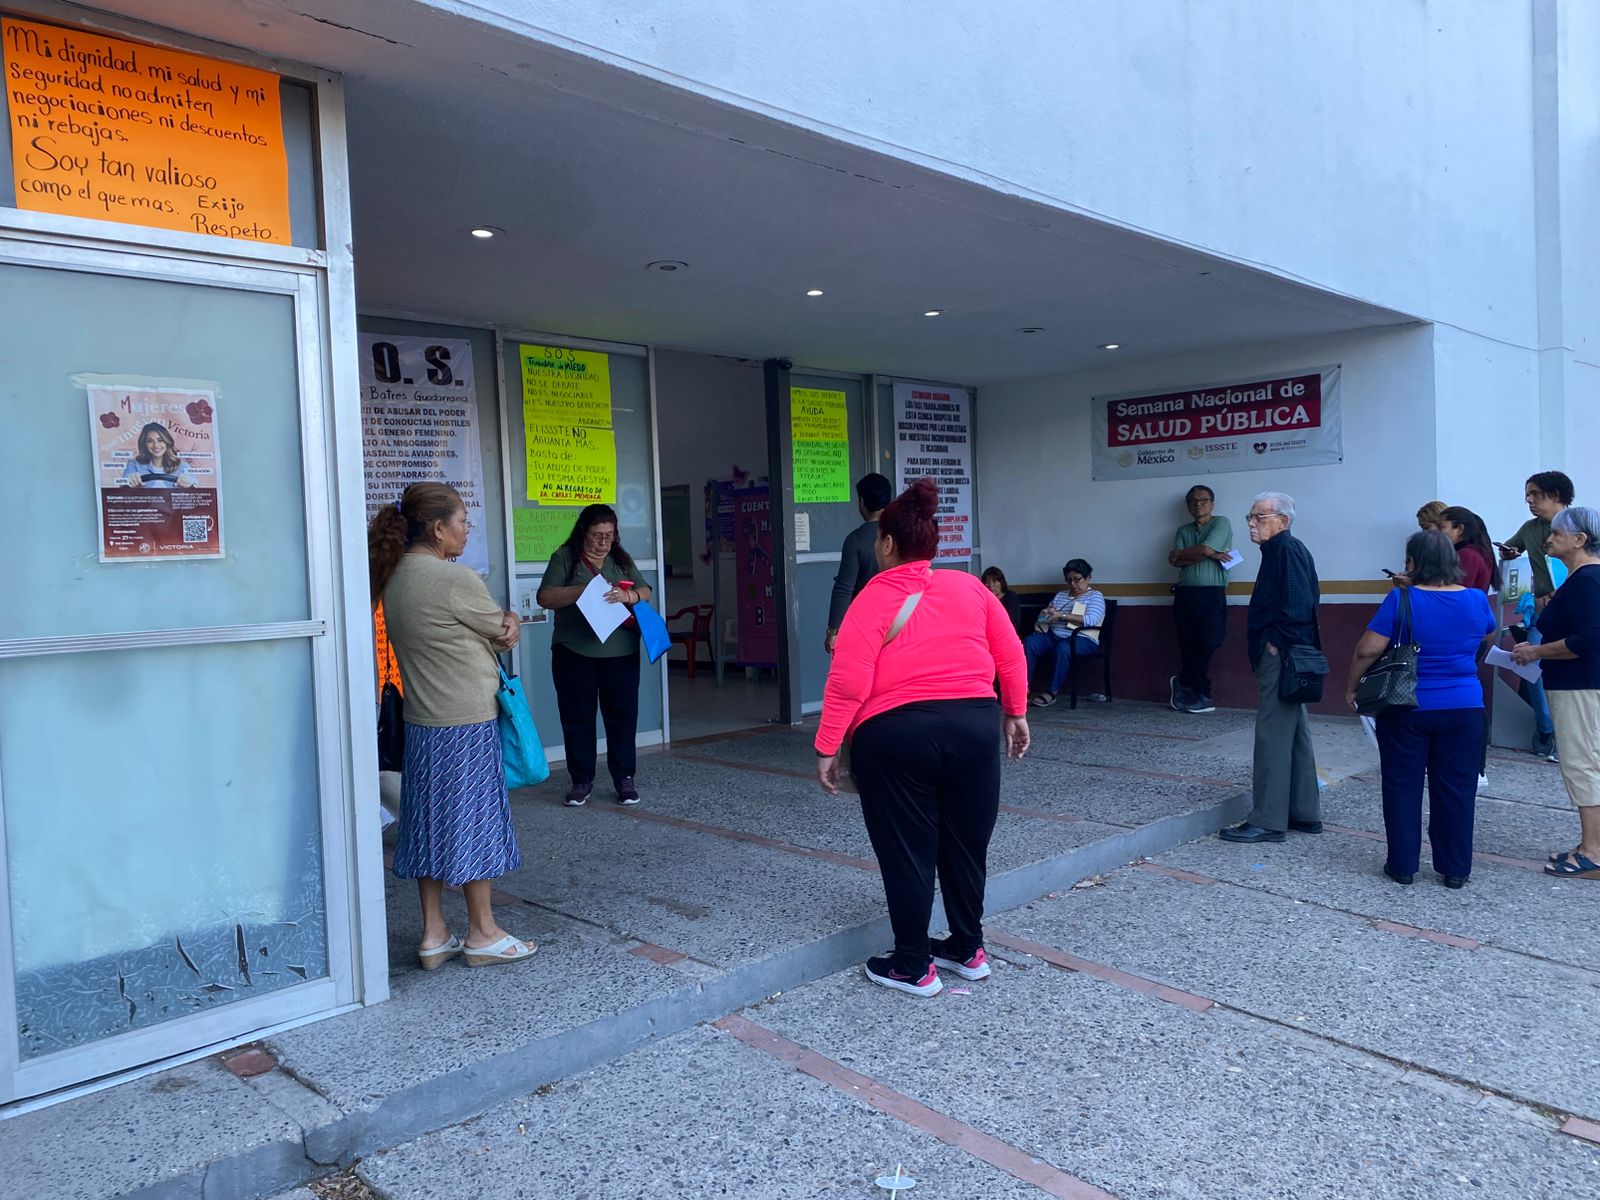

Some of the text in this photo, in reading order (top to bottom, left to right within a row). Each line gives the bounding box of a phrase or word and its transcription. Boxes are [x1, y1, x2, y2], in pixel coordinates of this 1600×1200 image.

[7, 25, 52, 58] Mi
[148, 64, 173, 83] mi
[178, 69, 223, 92] salud
[229, 83, 240, 104] y
[245, 86, 266, 106] mi
[111, 83, 131, 99] no
[134, 90, 214, 119] admiten
[12, 89, 268, 147] negociaciones ni descuentos
[18, 112, 129, 147] ni rebajas.
[25, 135, 217, 190] Soy tan valioso
[20, 178, 72, 203] como
[78, 180, 91, 200] el
[197, 194, 244, 219] Exijo
[527, 368, 563, 379] NUESTRA
[526, 378, 536, 386] NO
[552, 381, 579, 390] DEBATE
[370, 387, 468, 402] Batres Guadarrama
[1117, 380, 1305, 417] Semana Nacional de
[121, 395, 186, 415] Mujeres
[800, 406, 825, 416] AYUDA
[374, 407, 385, 415] DE
[387, 408, 421, 416] ABUSAR
[439, 409, 466, 417] PODER
[167, 419, 210, 440] Victoria
[384, 418, 432, 427] CONDUCTAS
[434, 419, 471, 428] HOSTILES
[1117, 405, 1311, 442] SALUD PÚBLICA
[365, 428, 457, 438] EL GENERO FEMENINO.
[542, 425, 587, 440] ISSSTE NO
[393, 440, 448, 448] MISOGISMO!!!
[532, 434, 571, 449] AGUANTA
[1205, 442, 1238, 452] ISSSTE
[398, 450, 409, 458] DE
[411, 450, 458, 459] AVIADORES,
[530, 449, 558, 460] Basta
[1137, 448, 1166, 456] Gobierno
[376, 461, 438, 469] COMPROMISOS
[1137, 454, 1175, 465] México
[547, 462, 571, 474] ABUSO
